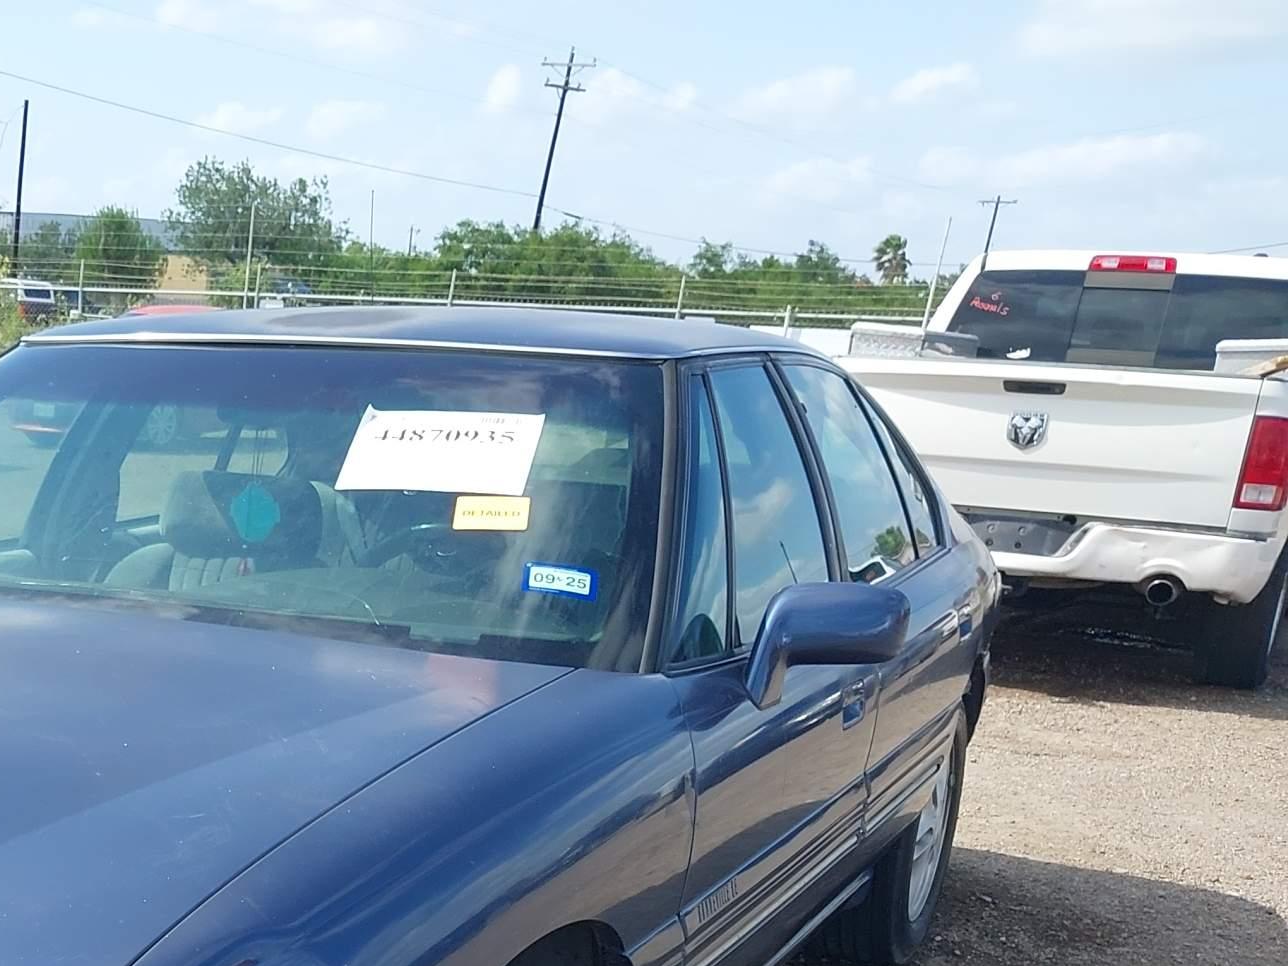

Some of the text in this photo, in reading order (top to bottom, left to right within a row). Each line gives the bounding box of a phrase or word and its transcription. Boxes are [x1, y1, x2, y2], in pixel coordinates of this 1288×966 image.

[375, 429, 516, 444] 44870935
[533, 572, 587, 589] 09 25
